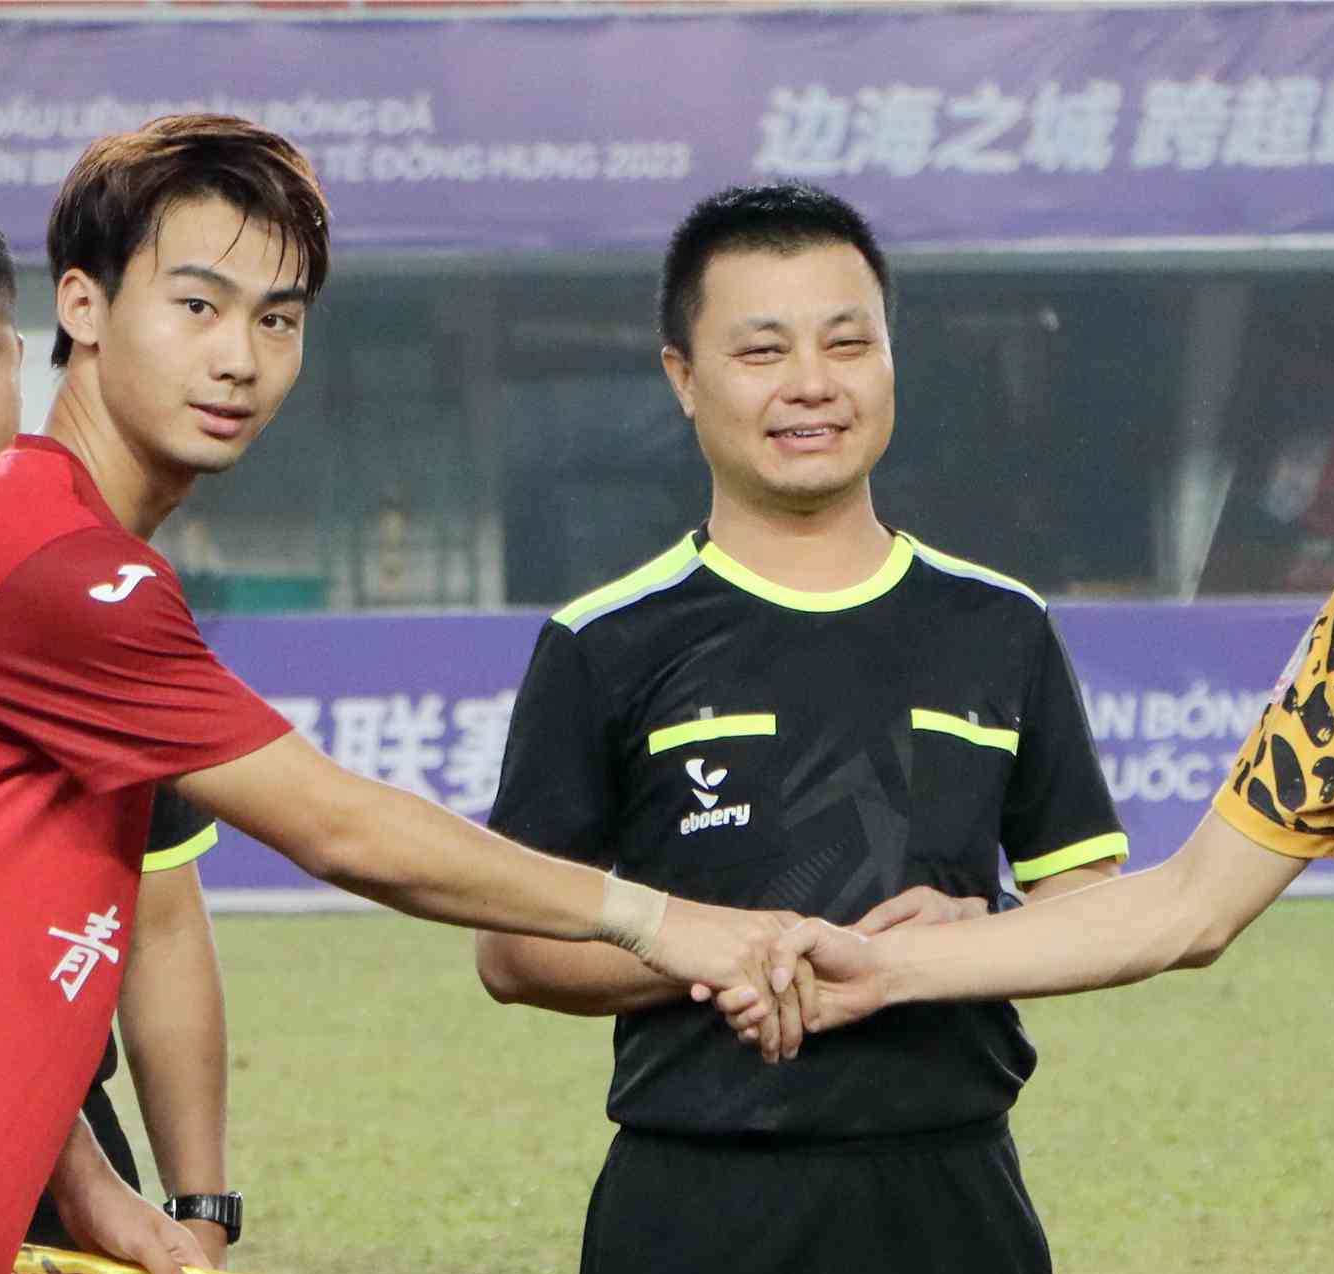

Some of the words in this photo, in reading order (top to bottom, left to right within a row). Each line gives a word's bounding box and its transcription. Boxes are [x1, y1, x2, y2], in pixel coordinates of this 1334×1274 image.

[755, 78, 1123, 178] 边海之城
[1142, 681, 1273, 741] BÓN
[679, 802, 751, 836] eboery
[48, 904, 122, 1002] 青
